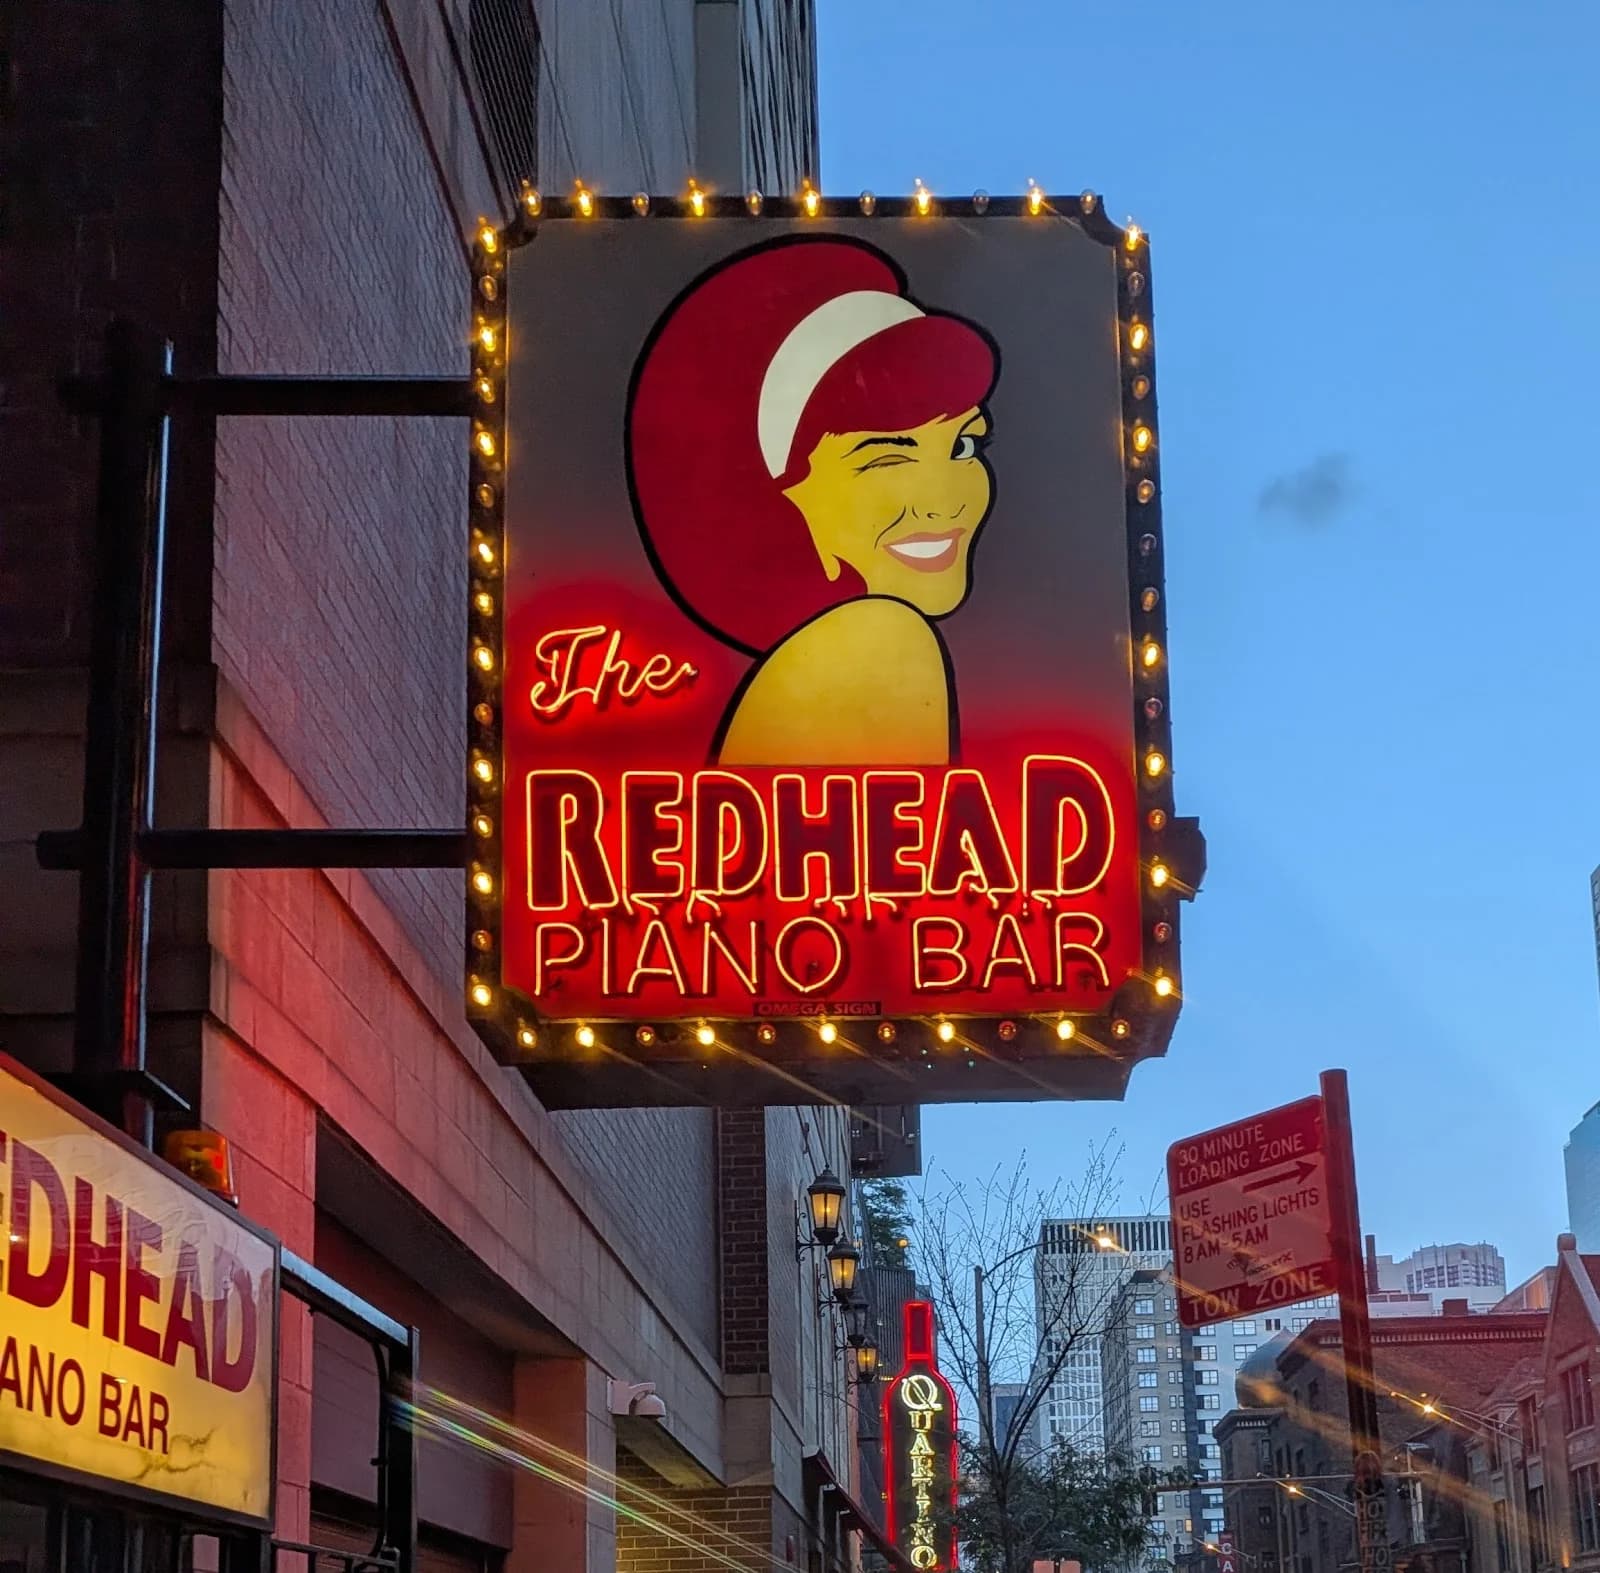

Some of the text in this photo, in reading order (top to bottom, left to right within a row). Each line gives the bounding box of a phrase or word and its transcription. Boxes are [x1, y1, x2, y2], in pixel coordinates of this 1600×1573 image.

[531, 625, 697, 713] The
[526, 754, 1115, 912] REDHEAD
[534, 912, 1110, 995] PIANO BAR
[758, 1002, 877, 1015] OMEGA SIGN
[1178, 1124, 1265, 1167] 30 MINUTE
[1178, 1133, 1305, 1188] LOADING ZONE
[1180, 1198, 1211, 1220] USE
[1182, 1188, 1319, 1242] FLASHING LIGHTS
[0, 1130, 257, 1393] DHEAD
[1188, 1266, 1325, 1321] TOW ZONE
[99, 1372, 170, 1455] BAR
[901, 1374, 943, 1569] QUARTINO
